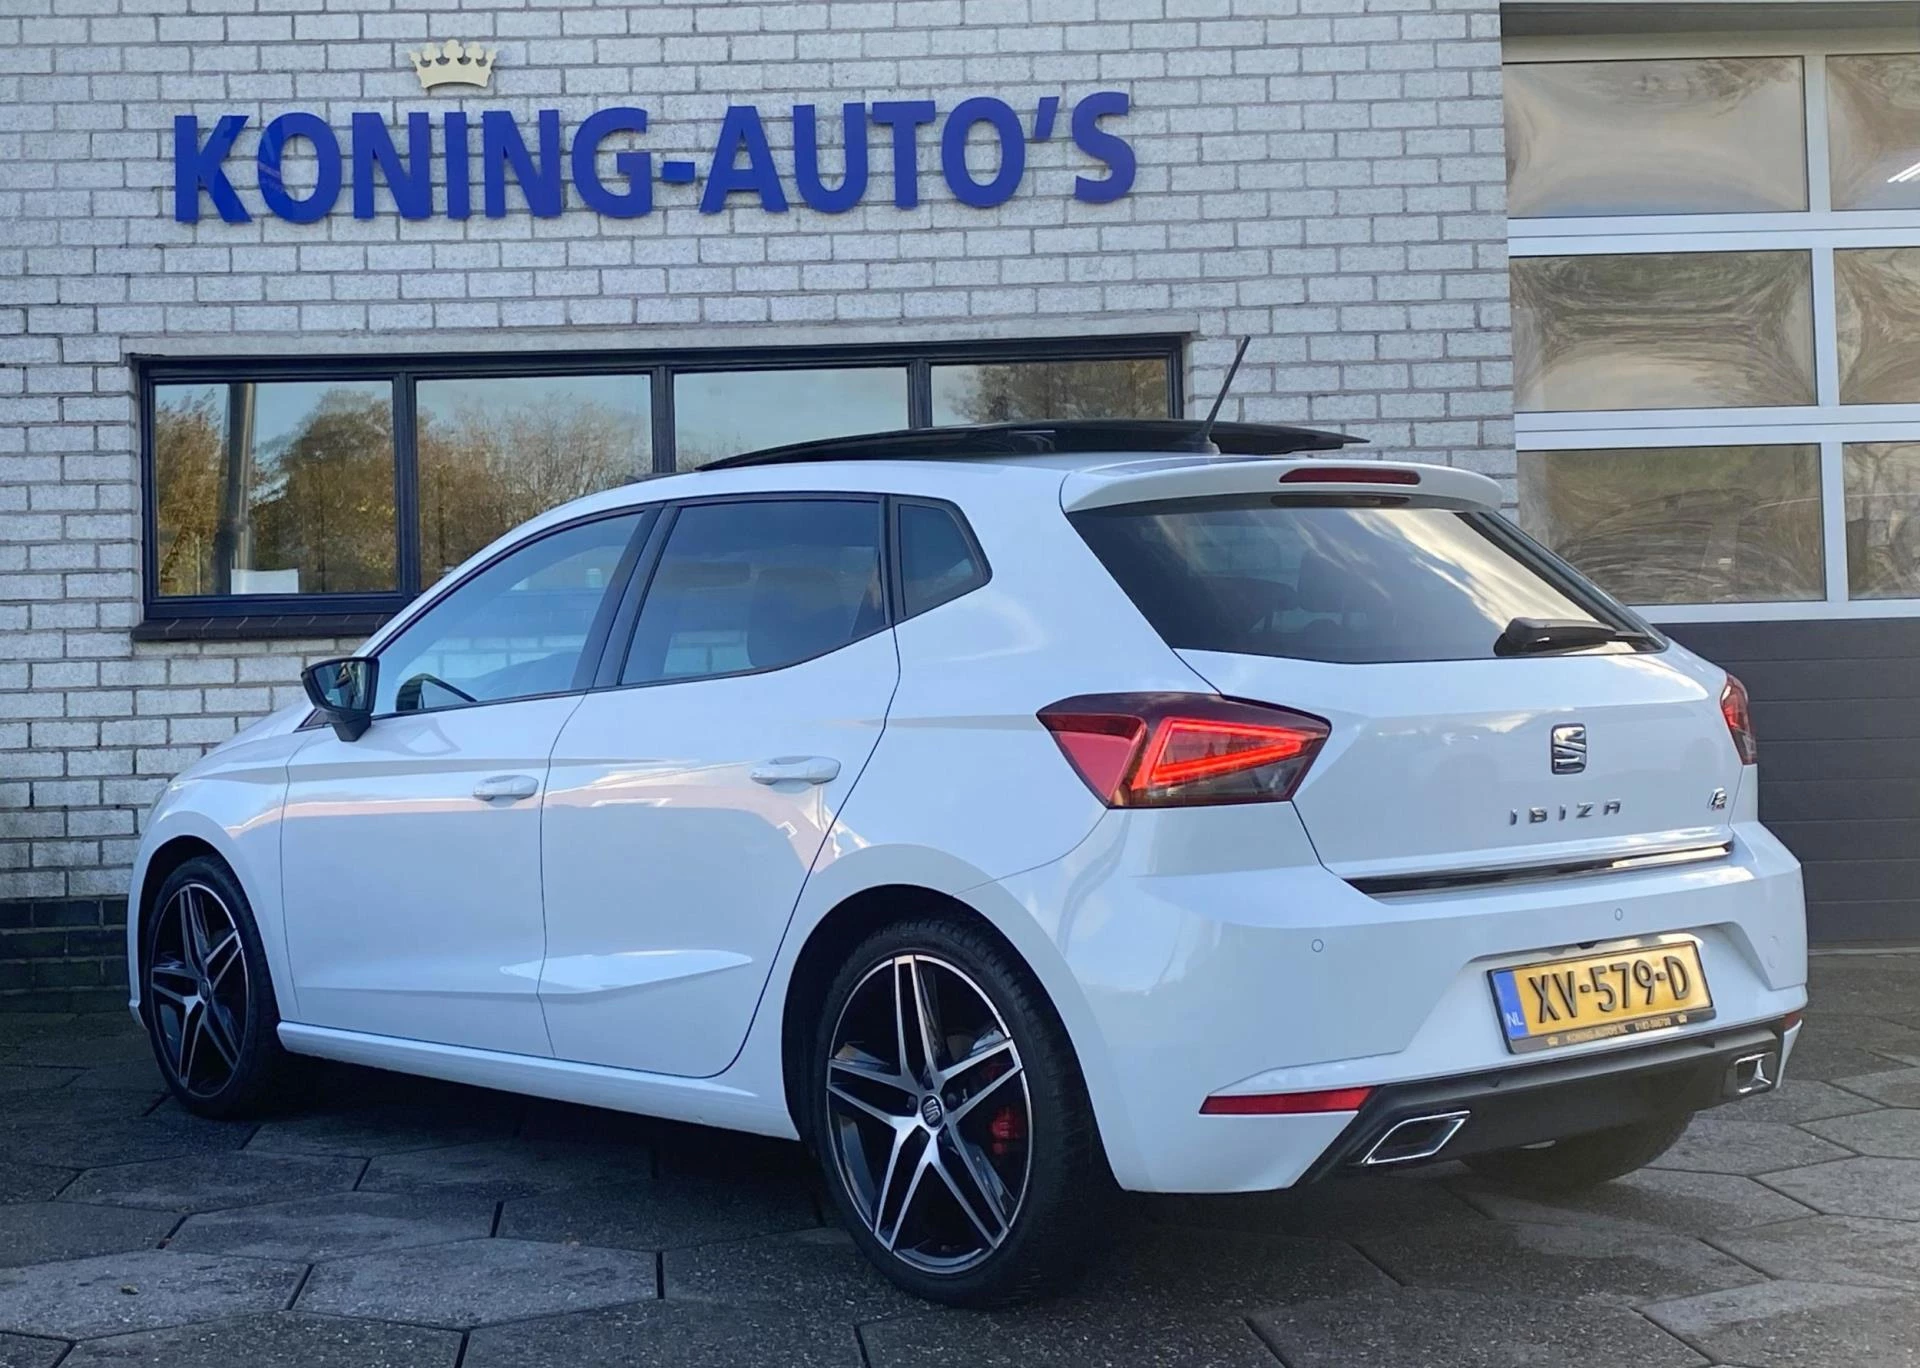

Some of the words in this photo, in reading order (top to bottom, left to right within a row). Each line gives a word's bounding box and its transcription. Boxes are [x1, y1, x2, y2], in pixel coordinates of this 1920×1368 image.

[174, 92, 1137, 224] KONING-AUTO'S
[1509, 800, 1621, 825] IBIZA
[1528, 955, 1690, 1023] XV-579-D
[1506, 1013, 1523, 1026] NL
